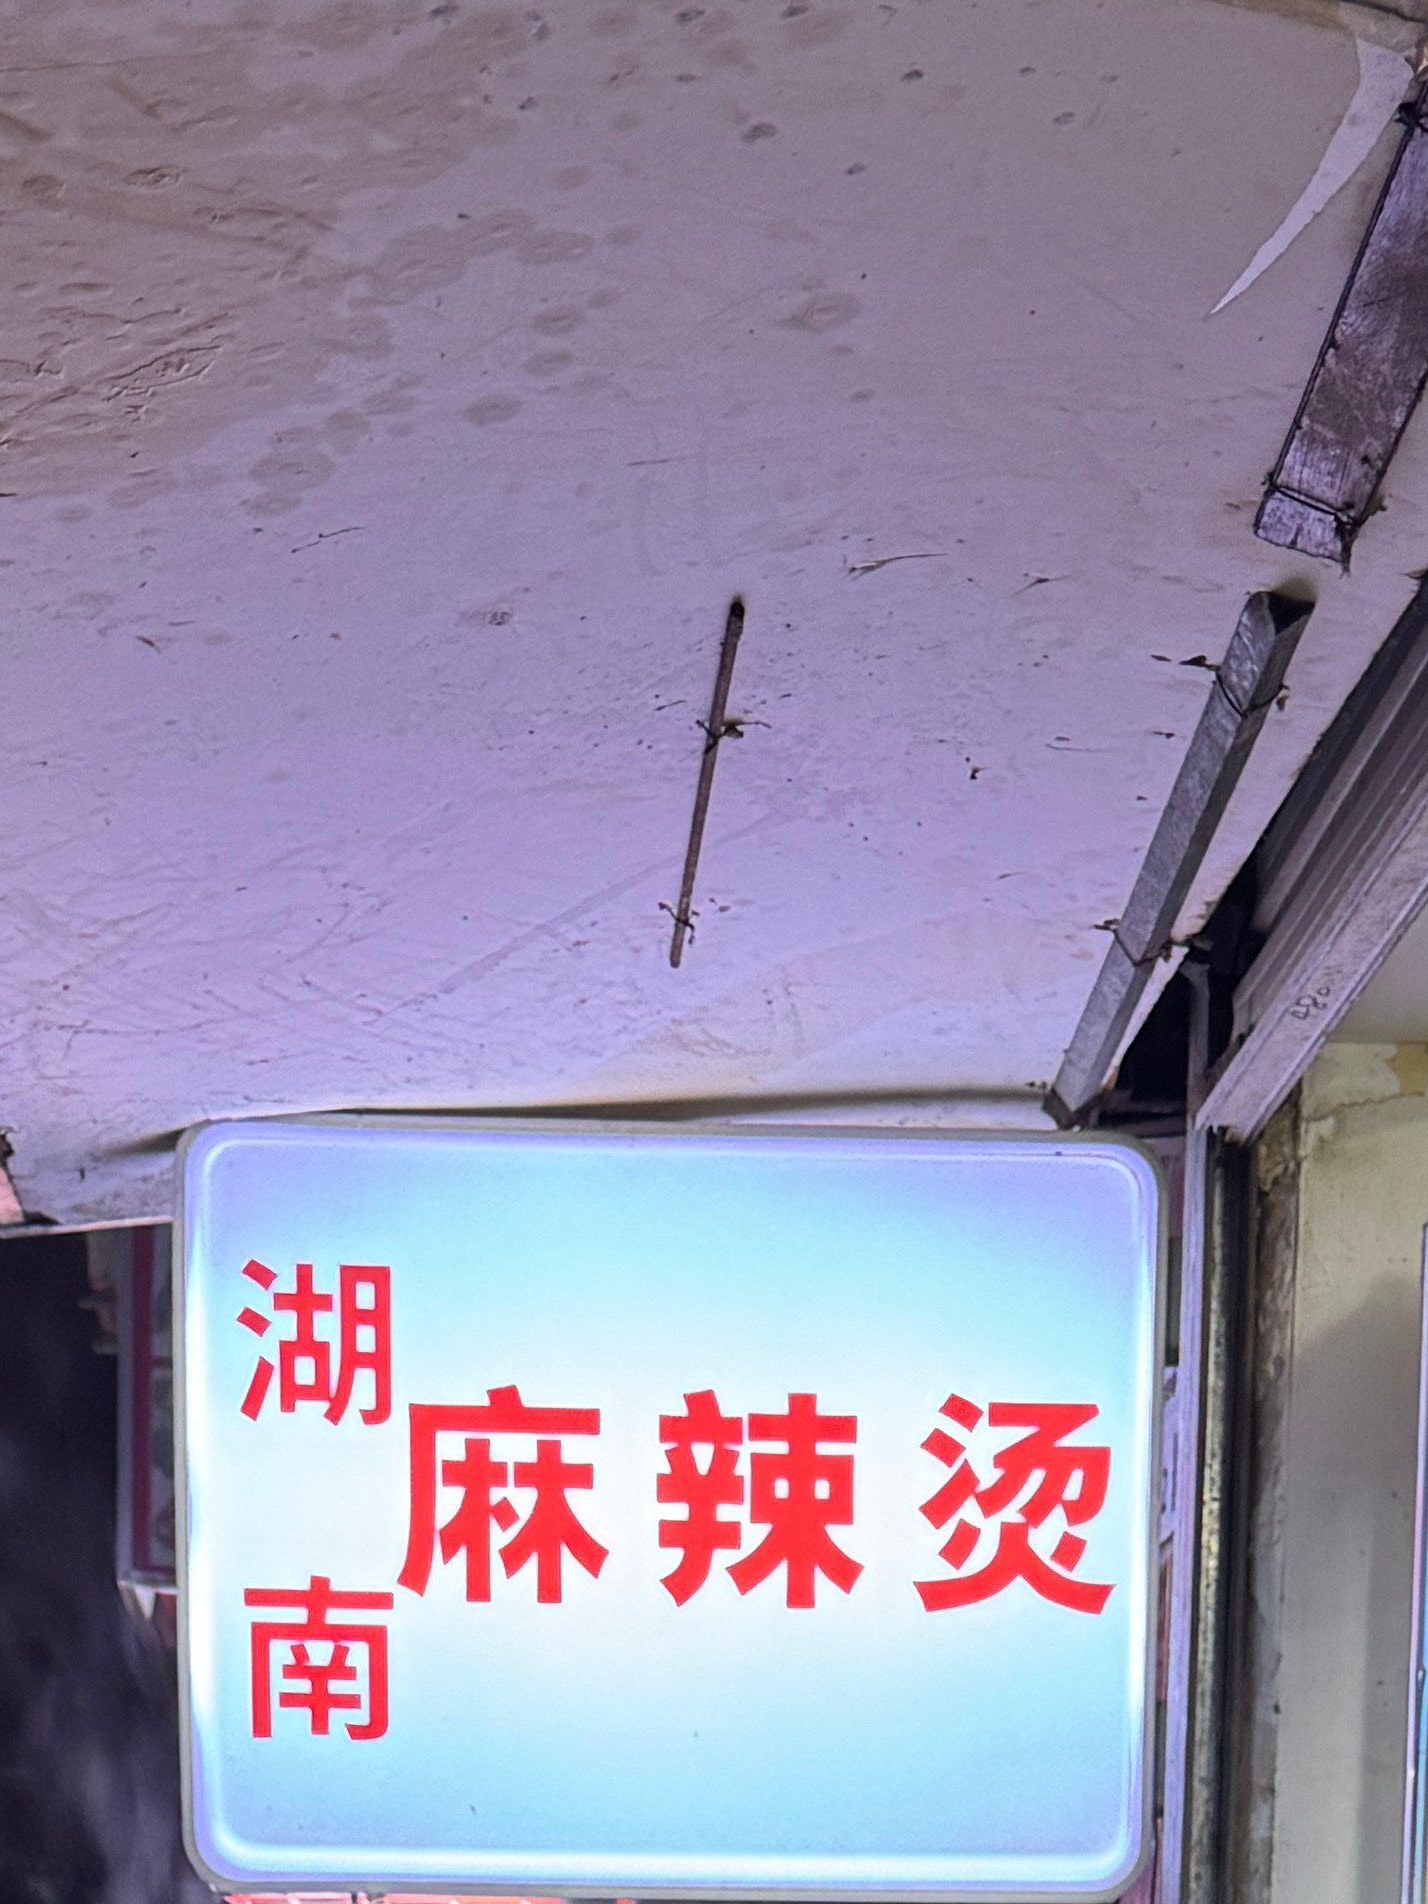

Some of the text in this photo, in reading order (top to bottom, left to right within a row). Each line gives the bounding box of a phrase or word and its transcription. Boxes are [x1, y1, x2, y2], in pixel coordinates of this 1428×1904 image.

[236, 1259, 393, 1741] 湖南
[397, 1384, 1116, 1614] 麻辣烫
